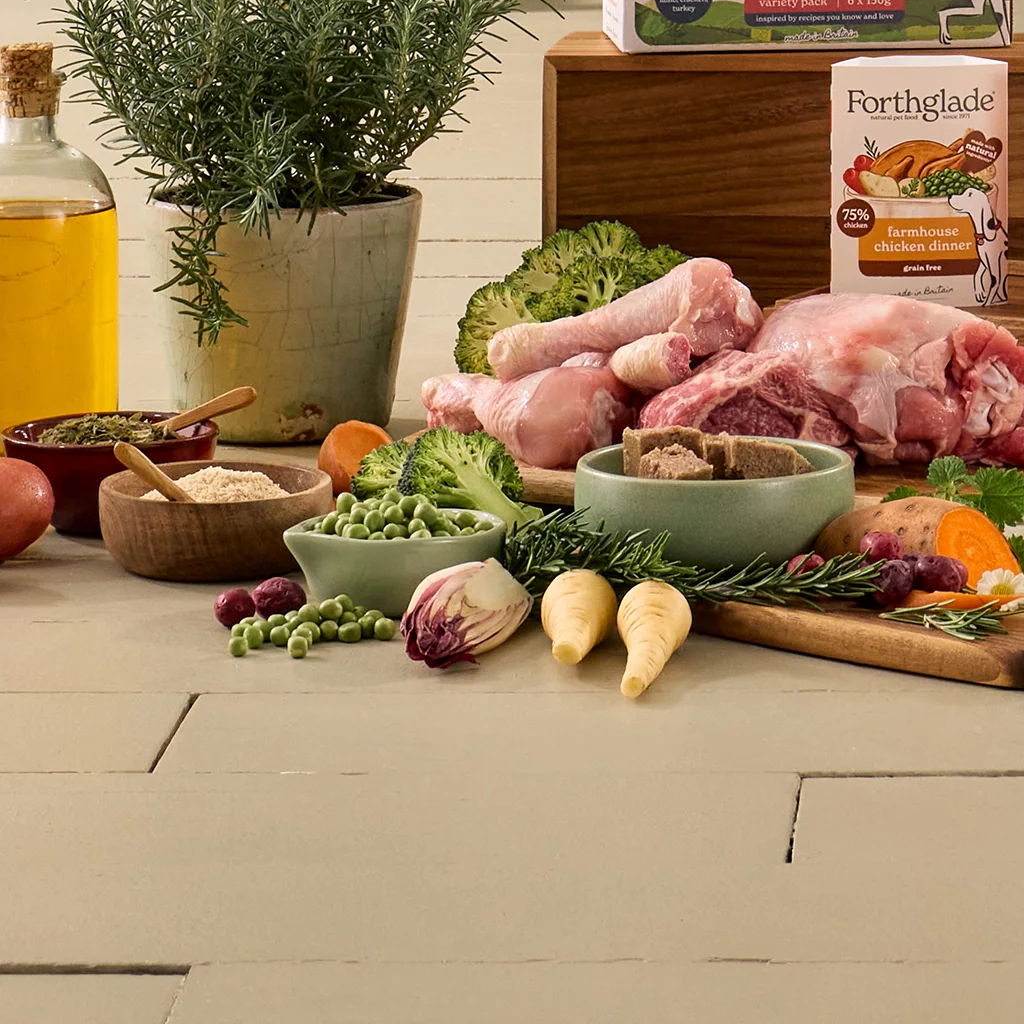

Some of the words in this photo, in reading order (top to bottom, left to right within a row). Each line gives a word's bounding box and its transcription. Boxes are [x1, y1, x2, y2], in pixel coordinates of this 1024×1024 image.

[672, 5, 696, 13] turkey
[798, 14, 825, 22] recipes
[784, 30, 811, 42] made
[824, 27, 858, 40] Britain
[847, 87, 994, 122] Forthglade
[970, 139, 984, 147] made
[965, 143, 997, 159] natural
[842, 208, 870, 221] 75%
[887, 226, 959, 237] farmhouse
[874, 240, 925, 252] chicken
[928, 240, 972, 251] dinner
[903, 264, 925, 272] grain
[924, 285, 953, 295] Britain
